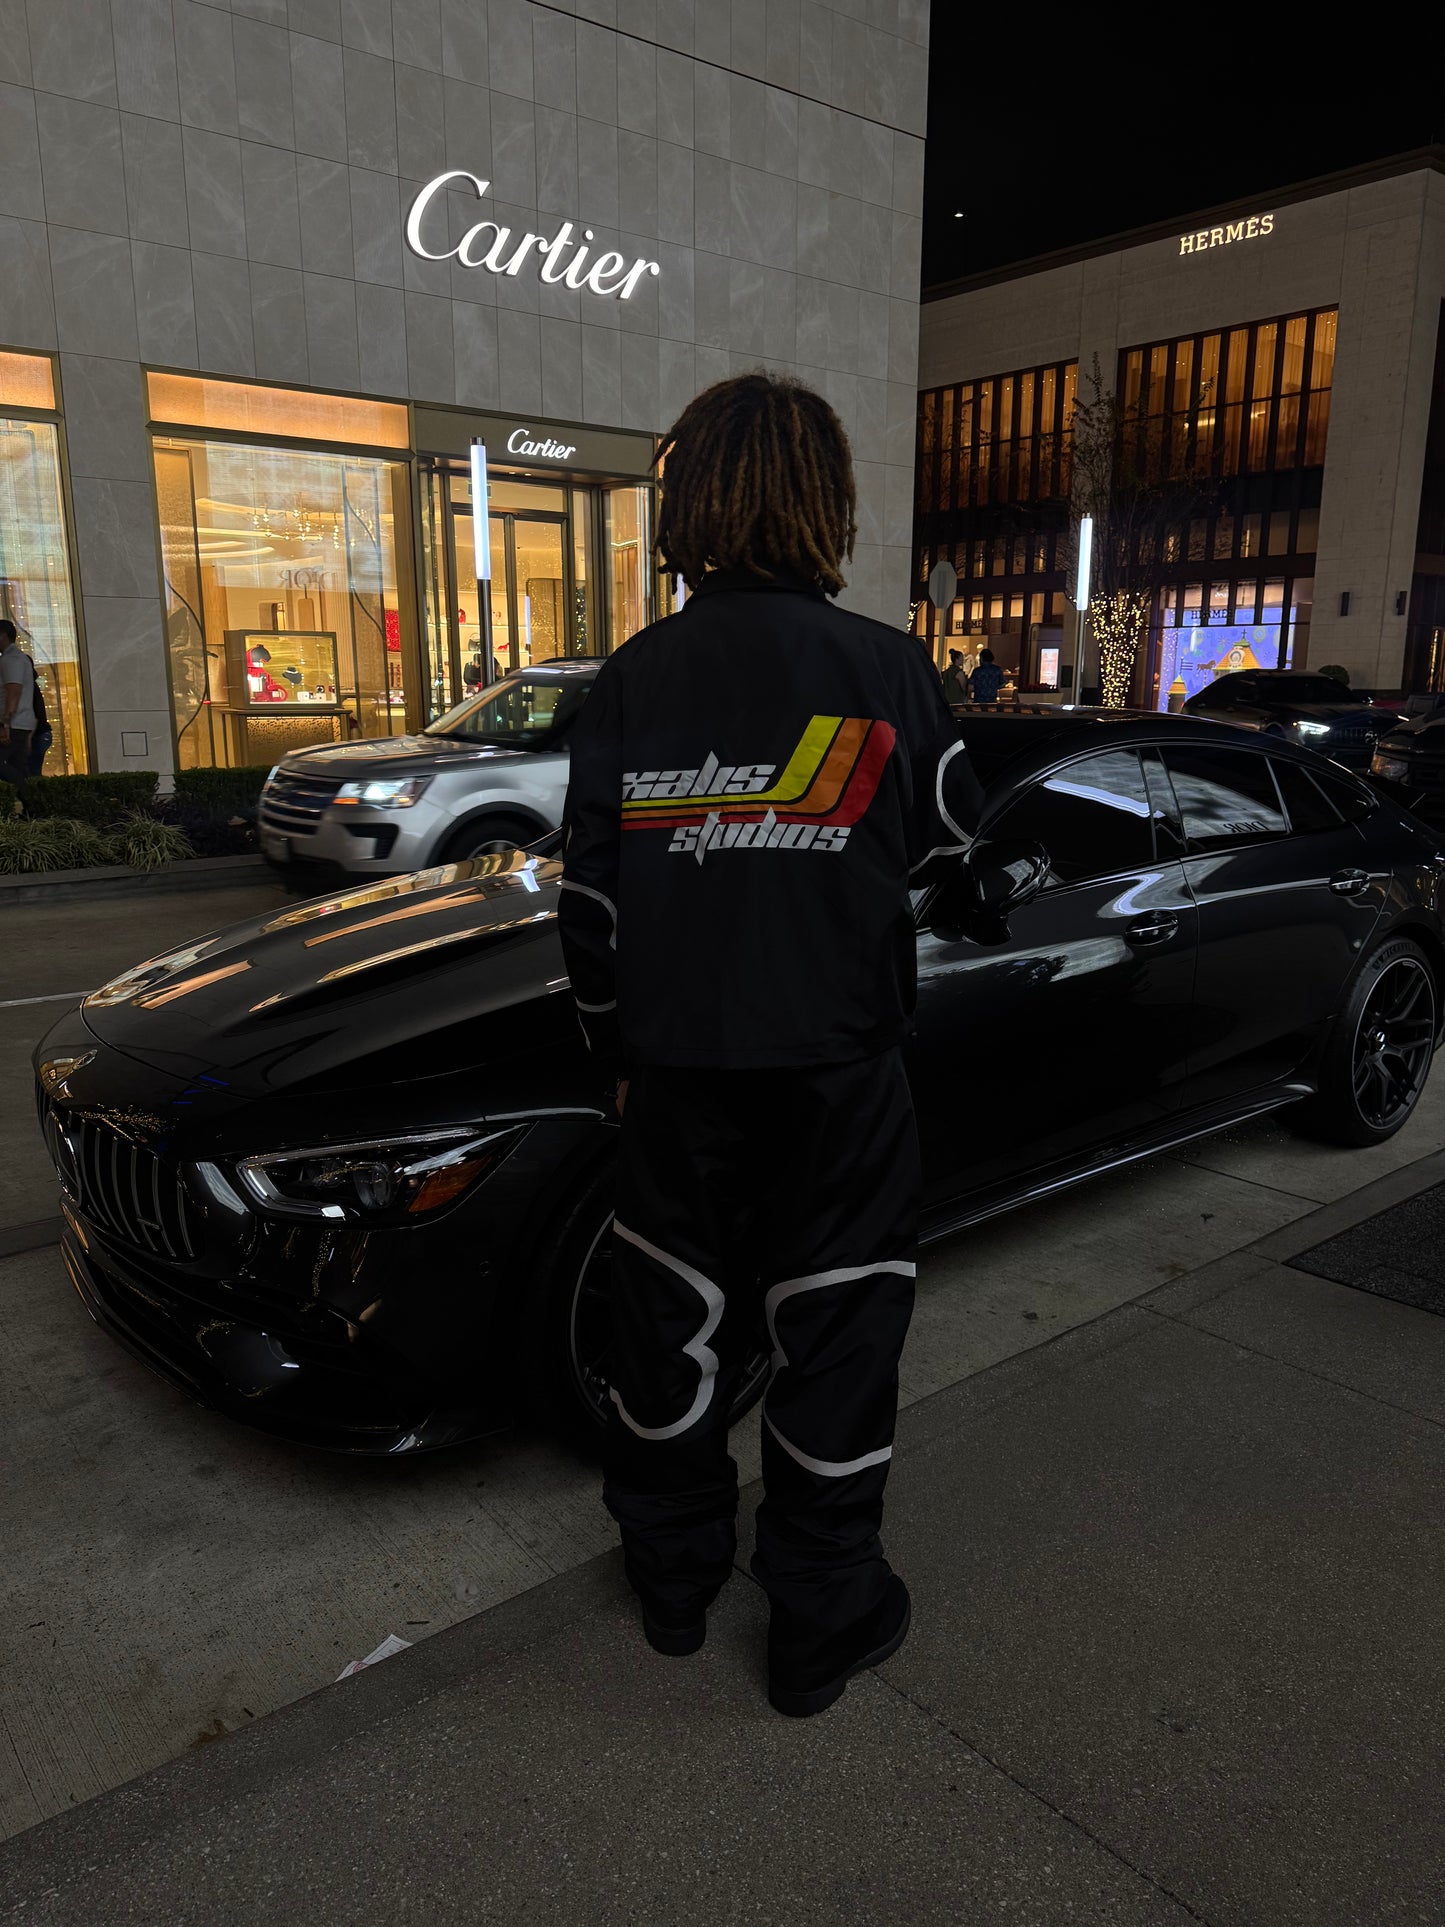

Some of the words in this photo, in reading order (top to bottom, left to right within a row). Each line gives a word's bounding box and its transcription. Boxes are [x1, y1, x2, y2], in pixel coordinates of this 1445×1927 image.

[406, 171, 660, 300] Cartier
[507, 428, 577, 460] Cartier
[668, 806, 851, 866] studios
